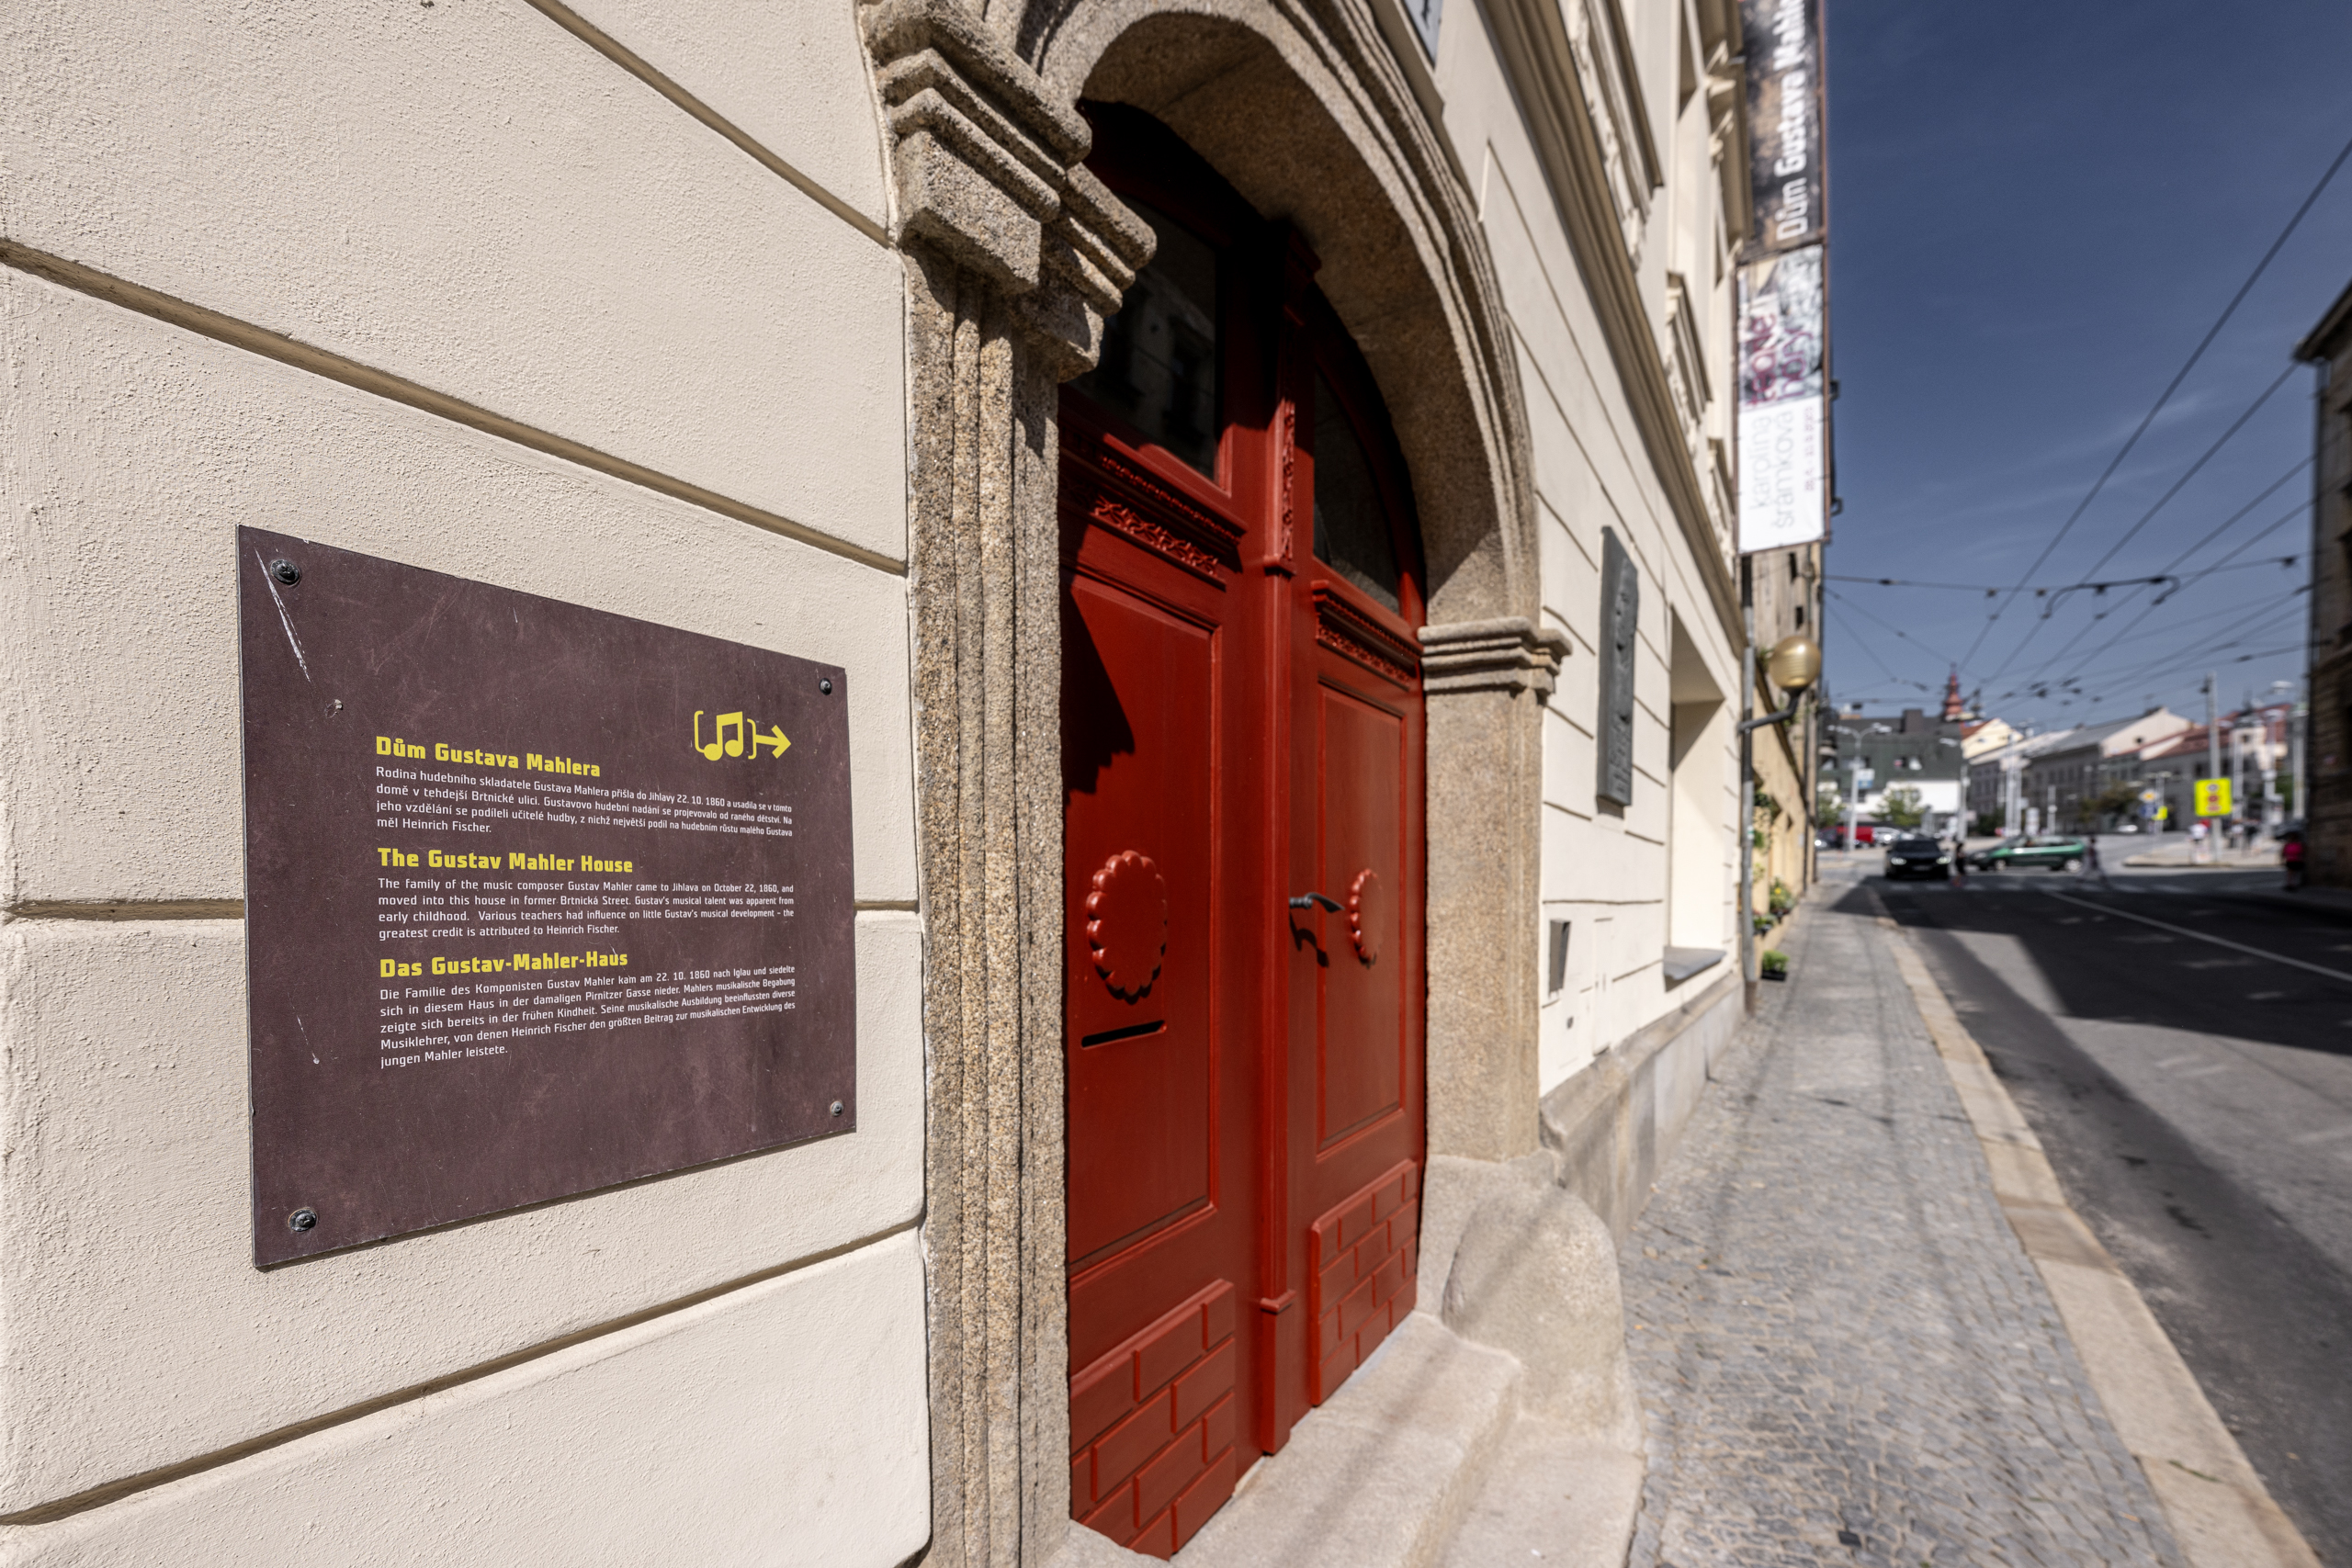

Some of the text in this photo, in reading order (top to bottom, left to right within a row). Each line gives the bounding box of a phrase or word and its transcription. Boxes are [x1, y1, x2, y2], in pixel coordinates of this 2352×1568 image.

[1773, 70, 1807, 177] Gustava
[1774, 177, 1808, 241] Dům
[1777, 328, 1814, 403] hory
[376, 736, 601, 777] Dům Gustava Mahlera
[376, 765, 792, 813] Rodina hudebního skladatele Gustava Mahlera přišla Jihlavy 22. 10. 1860 usadila tomto
[376, 783, 409, 796] domě
[424, 787, 468, 802] tehdejší
[471, 790, 514, 804] Brtnické
[517, 795, 540, 806] ulici.
[543, 796, 593, 810] Gustavovo
[594, 800, 630, 813] hudební
[631, 804, 660, 815] nadání
[673, 808, 718, 819] projevovalo
[730, 812, 755, 822] raného
[783, 816, 793, 825] Na
[376, 799, 793, 837] jeho vzdělání podíleli učitelé hudby, nichž největší podíl hudebním růstu malého Gustava
[377, 817, 492, 833] měl Heinrich Fischer.
[377, 847, 633, 874] The Gustav Mahler House
[378, 877, 794, 894] The family the music composer Gustav Mahler came Jihlava October 22, 1860, and
[378, 895, 417, 906] moved
[422, 895, 445, 906] into
[449, 895, 470, 906] this
[474, 895, 506, 906] house
[510, 896, 520, 906] in
[524, 895, 557, 906] former
[560, 895, 599, 906] Brtnická
[602, 895, 631, 906] Street.
[673, 896, 702, 905] musical
[704, 896, 727, 905] talent
[745, 897, 777, 907] apparent
[778, 896, 795, 905] from
[379, 911, 409, 924] early
[413, 910, 469, 922] childhood.
[478, 910, 517, 921] Various
[520, 909, 563, 920] teachers
[566, 909, 583, 920] had
[586, 909, 627, 919] influence
[642, 909, 662, 919] little
[700, 908, 729, 919] musical
[730, 908, 775, 919] development
[783, 908, 795, 917] the
[379, 923, 620, 942] greatest credit attributed Heinrich Fischer.
[379, 950, 628, 978] Das Gustav-Mahler-Haus
[379, 964, 796, 1000] Die Familie des Komponisten Gustav Mahler kam 22. 10. 1860 nach Iglau und siedelte
[379, 977, 796, 1017] sich in diesem Haus in der damaligen Pirnitzer Gasse nieder. Mahlers musikalische Begabung
[379, 990, 796, 1034] zeigte sich bereits in der frühen Kindheit. Seine musikalische Ausbildung beeinflussten diverse
[380, 1001, 796, 1050] Musiklehrer, von denen Heinrich Fischer den größten Beitrag zur musikalischen Entwicklung des
[380, 1044, 508, 1070] jungen Mahler leistete.
